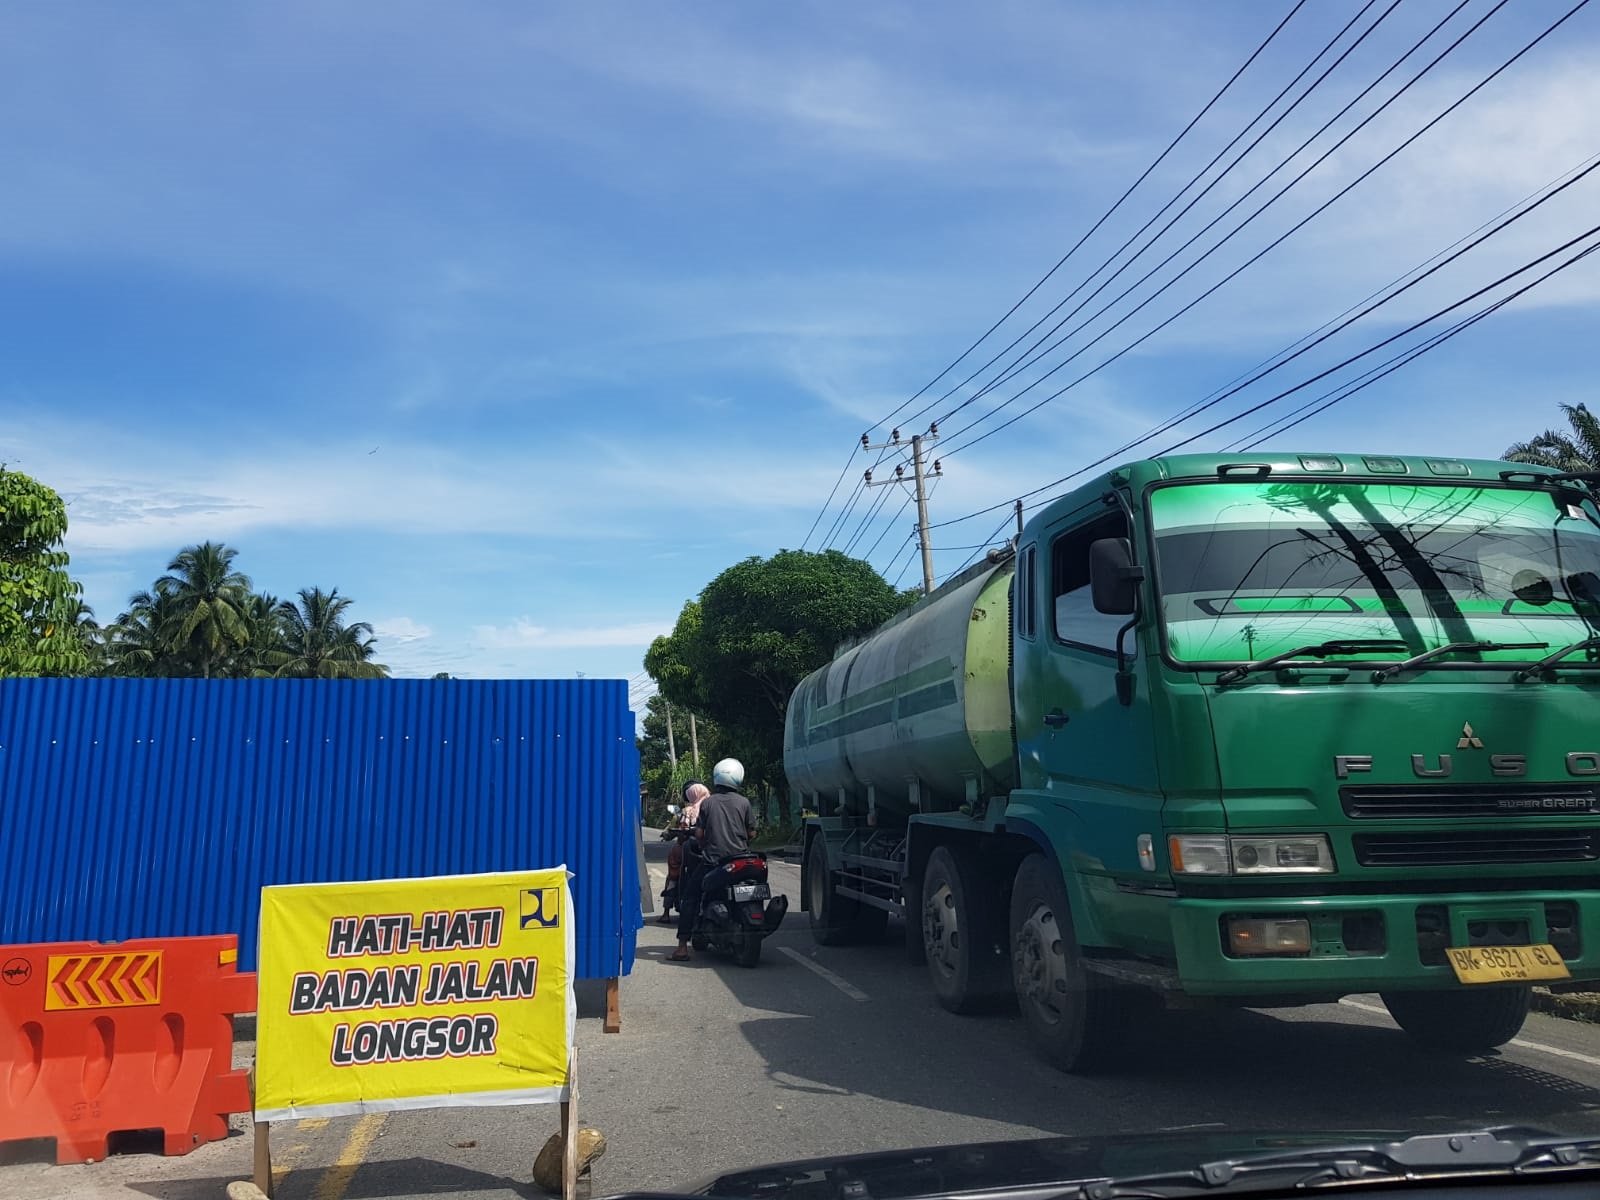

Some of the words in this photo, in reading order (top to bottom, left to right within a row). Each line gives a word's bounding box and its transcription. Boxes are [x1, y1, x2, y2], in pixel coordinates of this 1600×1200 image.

[1335, 752, 1600, 778] FUSO
[1498, 799, 1540, 809] SUPER
[1543, 797, 1596, 809] GREAT
[329, 907, 504, 958] HATI-HATI
[1453, 950, 1479, 971] BK
[1481, 948, 1526, 968] 8621
[289, 964, 421, 1015] BADAN
[423, 957, 538, 1006] JALAN
[331, 1013, 498, 1067] LONGSOR
